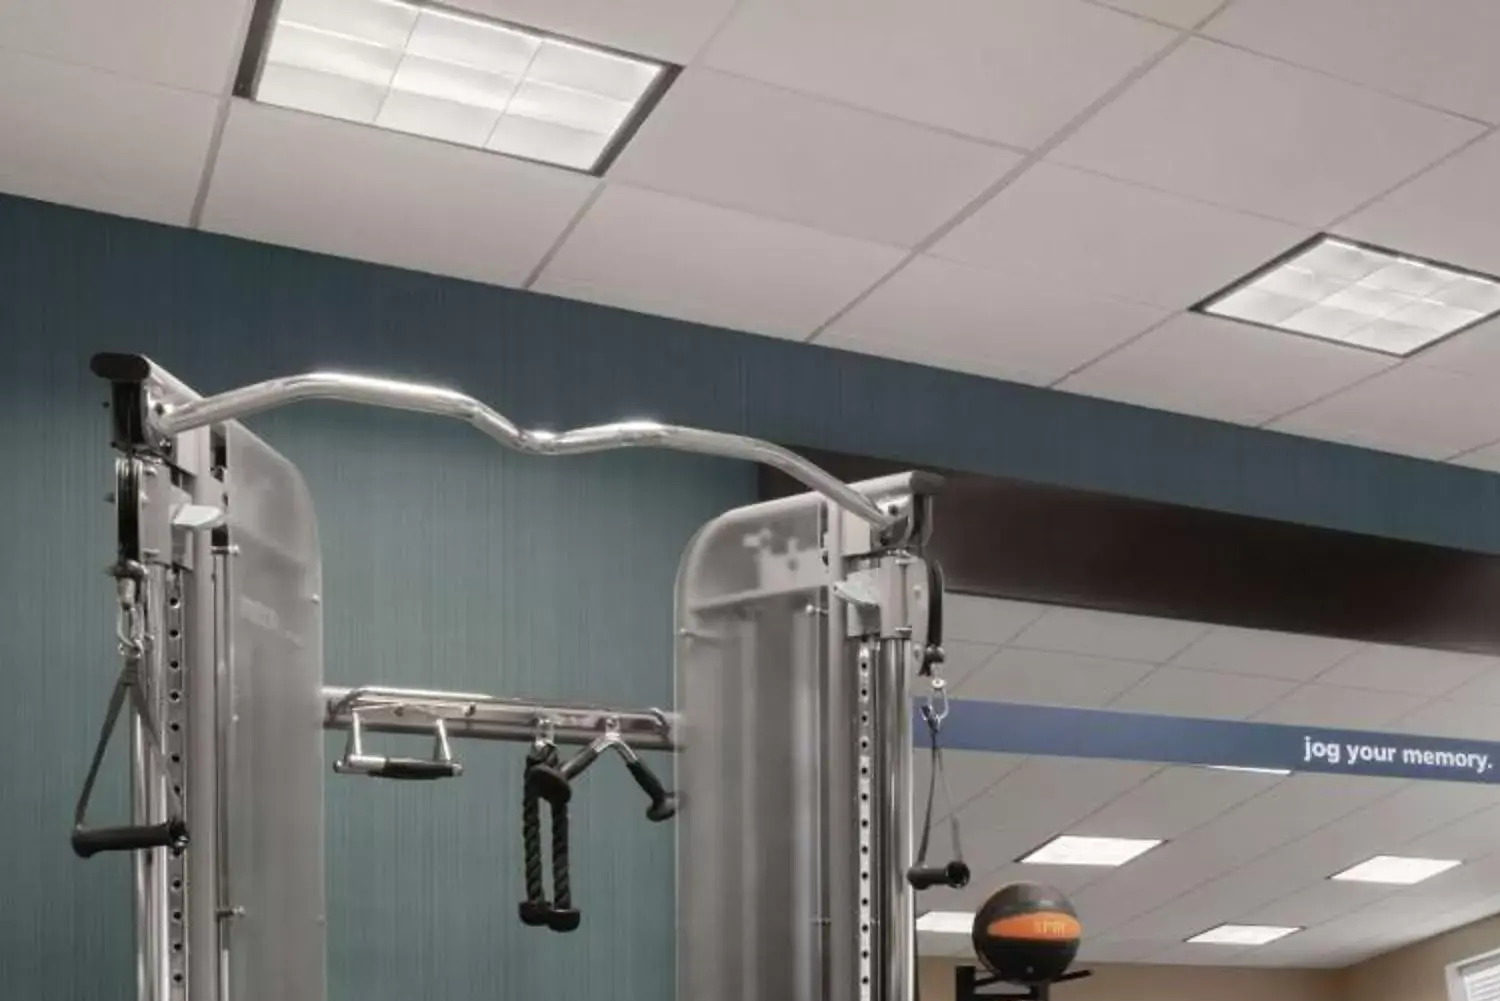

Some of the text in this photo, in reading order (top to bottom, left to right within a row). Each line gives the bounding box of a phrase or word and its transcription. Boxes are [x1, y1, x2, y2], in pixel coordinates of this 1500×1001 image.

[1304, 736, 1493, 773] jog your memory.
